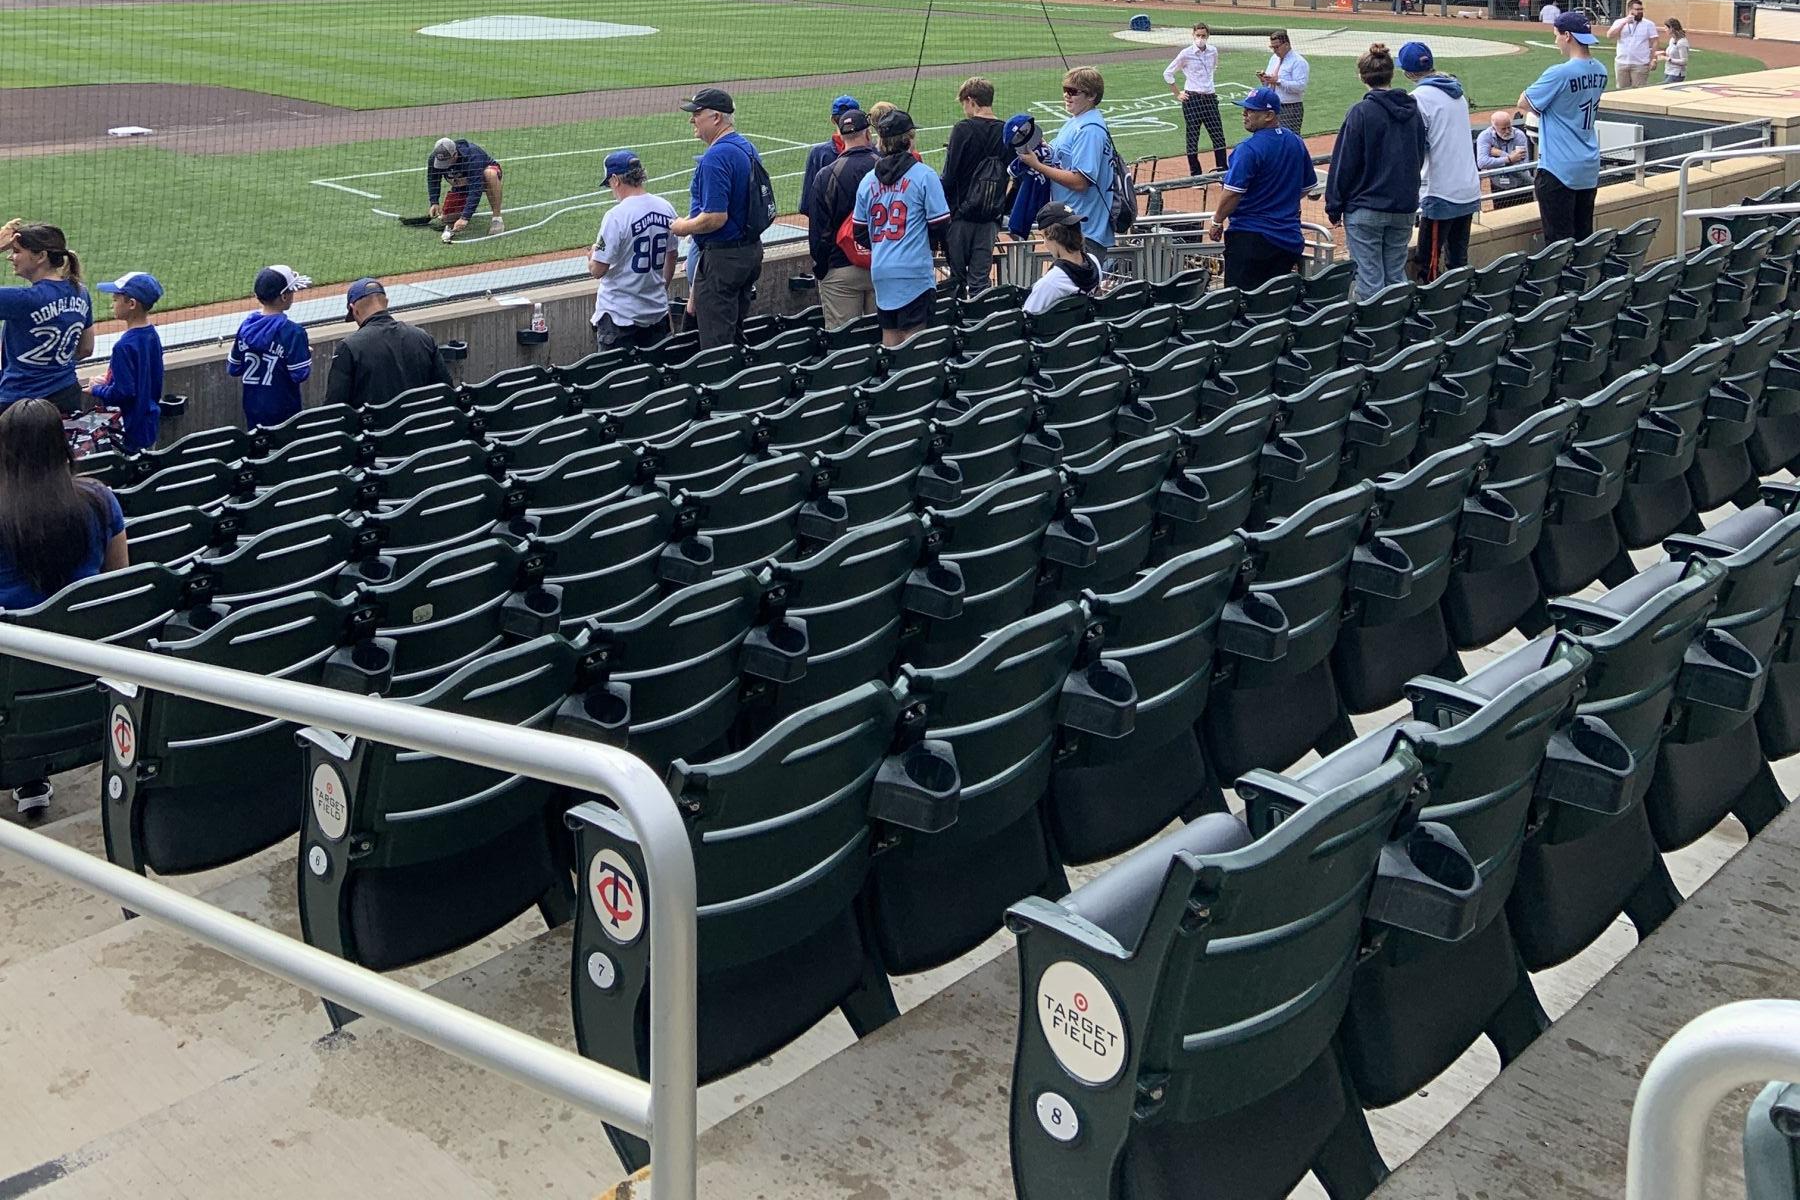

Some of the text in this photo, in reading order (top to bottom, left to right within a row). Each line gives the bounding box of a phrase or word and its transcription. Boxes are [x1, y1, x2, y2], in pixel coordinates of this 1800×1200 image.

[634, 213, 672, 233] SUMMIT
[870, 200, 908, 243] 29
[30, 296, 89, 324] DONALDSON
[16, 322, 85, 366] 20
[242, 352, 278, 386] 27
[314, 786, 345, 813] TARGET
[319, 800, 341, 820] FIELD
[316, 856, 320, 866] 6
[598, 963, 605, 976] 7
[1044, 994, 1118, 1046] TARGET
[1053, 1017, 1106, 1056] FIELD
[1051, 1108, 1062, 1125] 8
